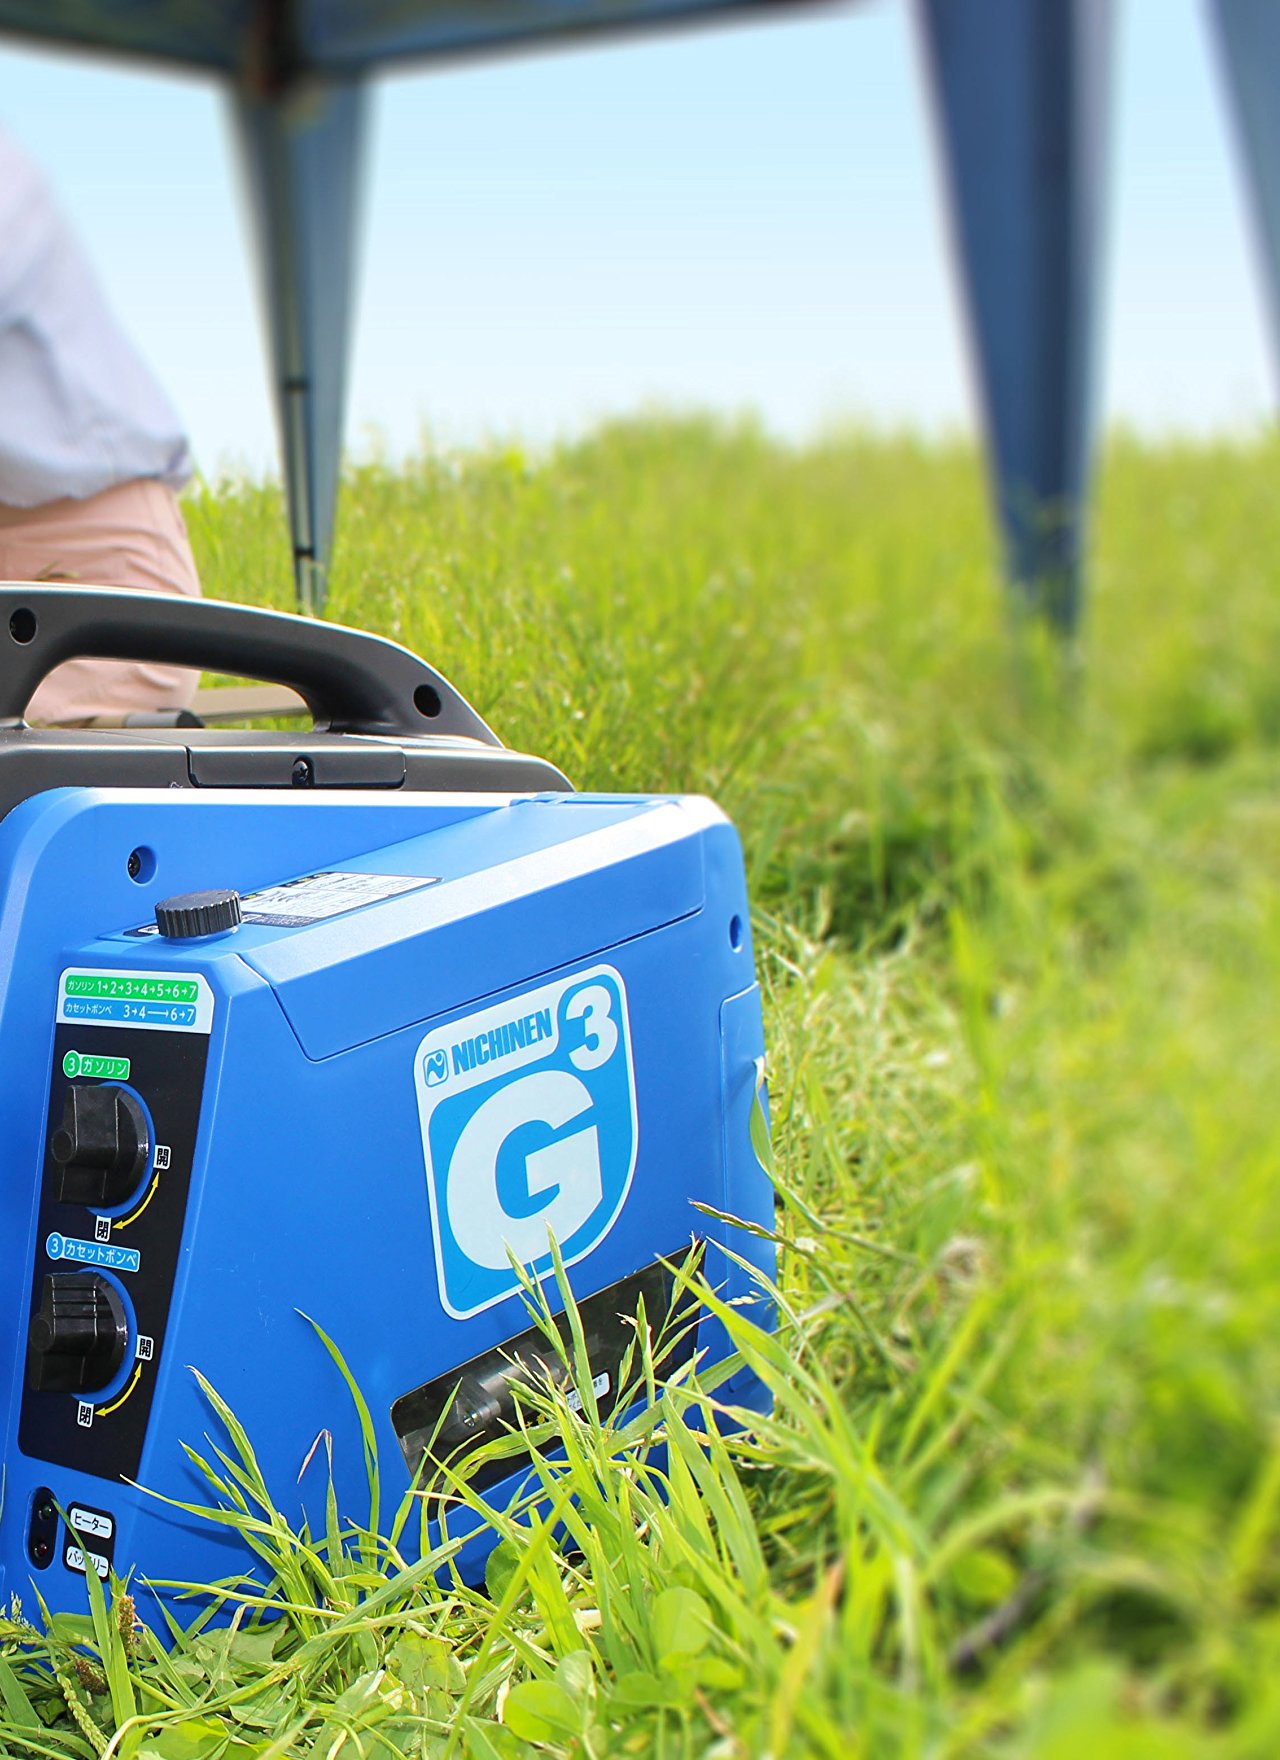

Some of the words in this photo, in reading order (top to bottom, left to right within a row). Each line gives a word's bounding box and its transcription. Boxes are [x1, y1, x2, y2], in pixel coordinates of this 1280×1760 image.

[67, 980, 95, 991] ガソリン
[66, 1003, 112, 1015] カセットボンベ
[565, 984, 619, 1072] 3
[451, 1008, 553, 1076] NICHINEN
[83, 1058, 127, 1075] ガソリン
[446, 1069, 604, 1271] G
[66, 1242, 138, 1267] カセットボンベ
[74, 1512, 109, 1531] ヒーター
